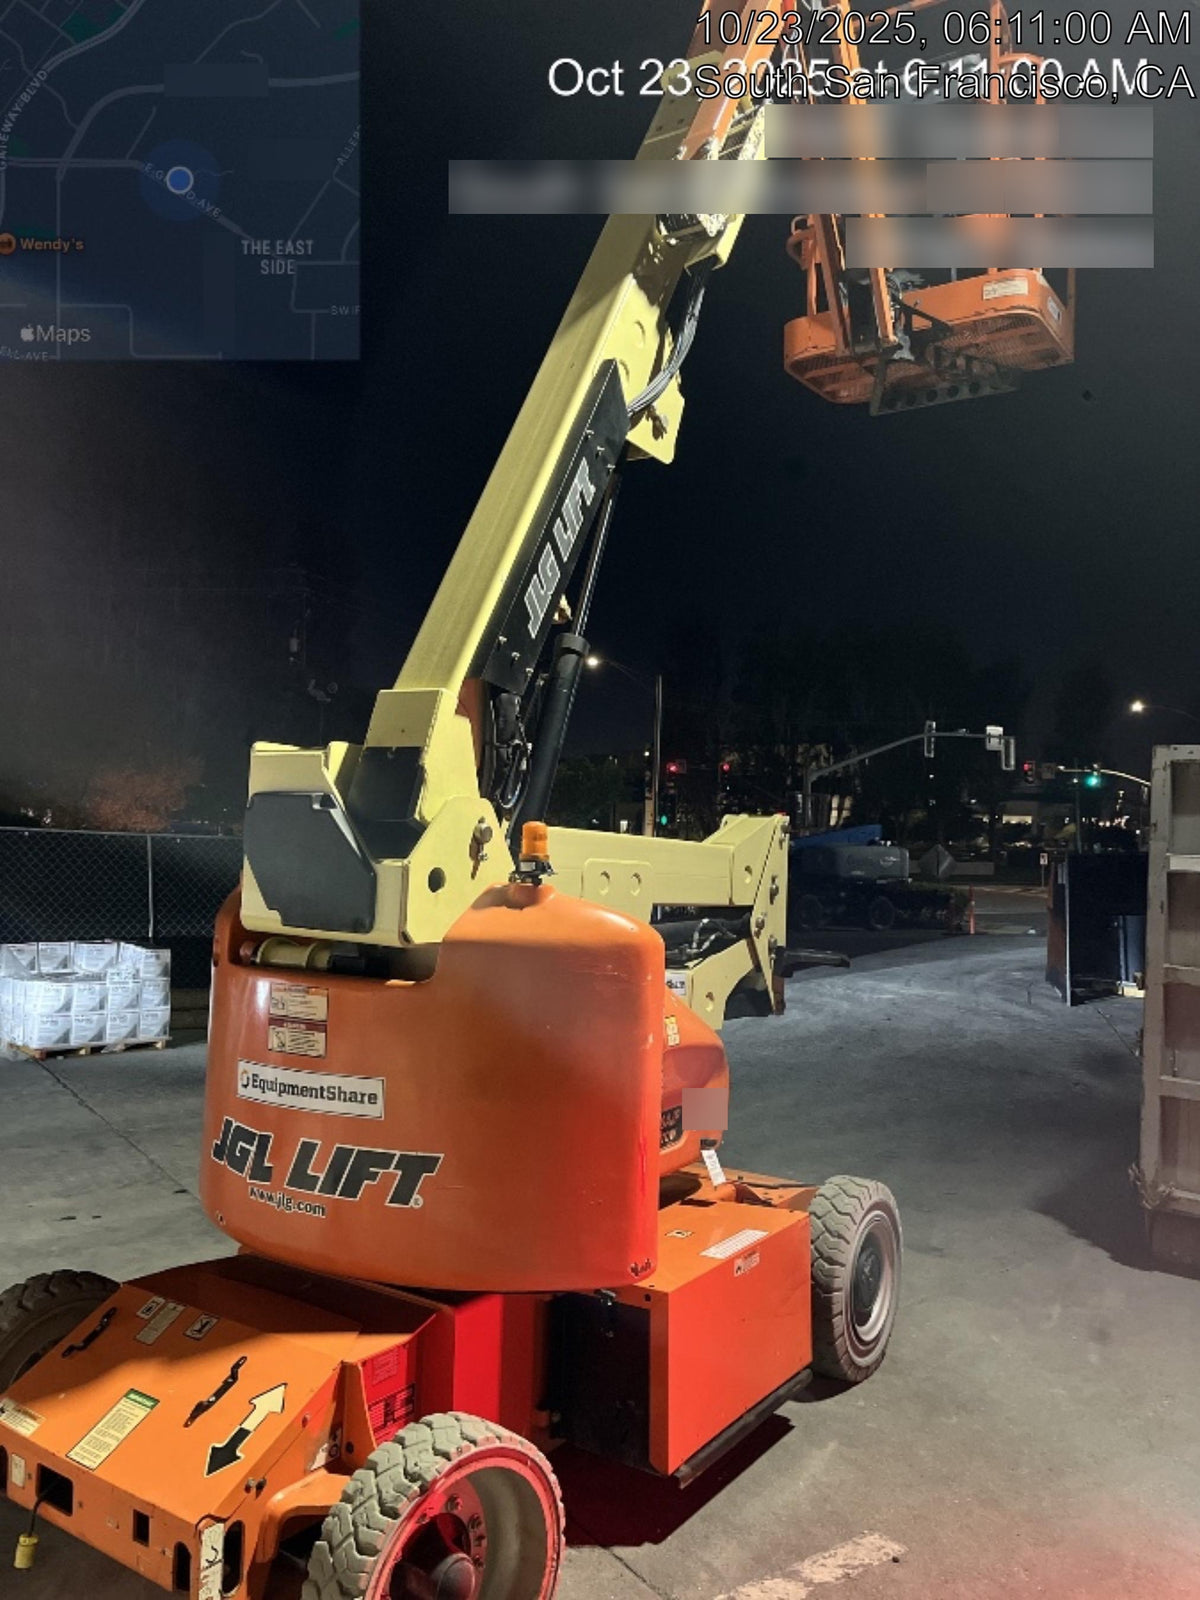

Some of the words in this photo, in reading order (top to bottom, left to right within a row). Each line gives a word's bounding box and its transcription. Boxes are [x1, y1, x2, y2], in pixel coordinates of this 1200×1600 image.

[552, 456, 597, 563] LIFT
[252, 1073, 378, 1105] EquipmentShare
[211, 1115, 274, 1185] JGL
[248, 1186, 326, 1218] www.jlg.com
